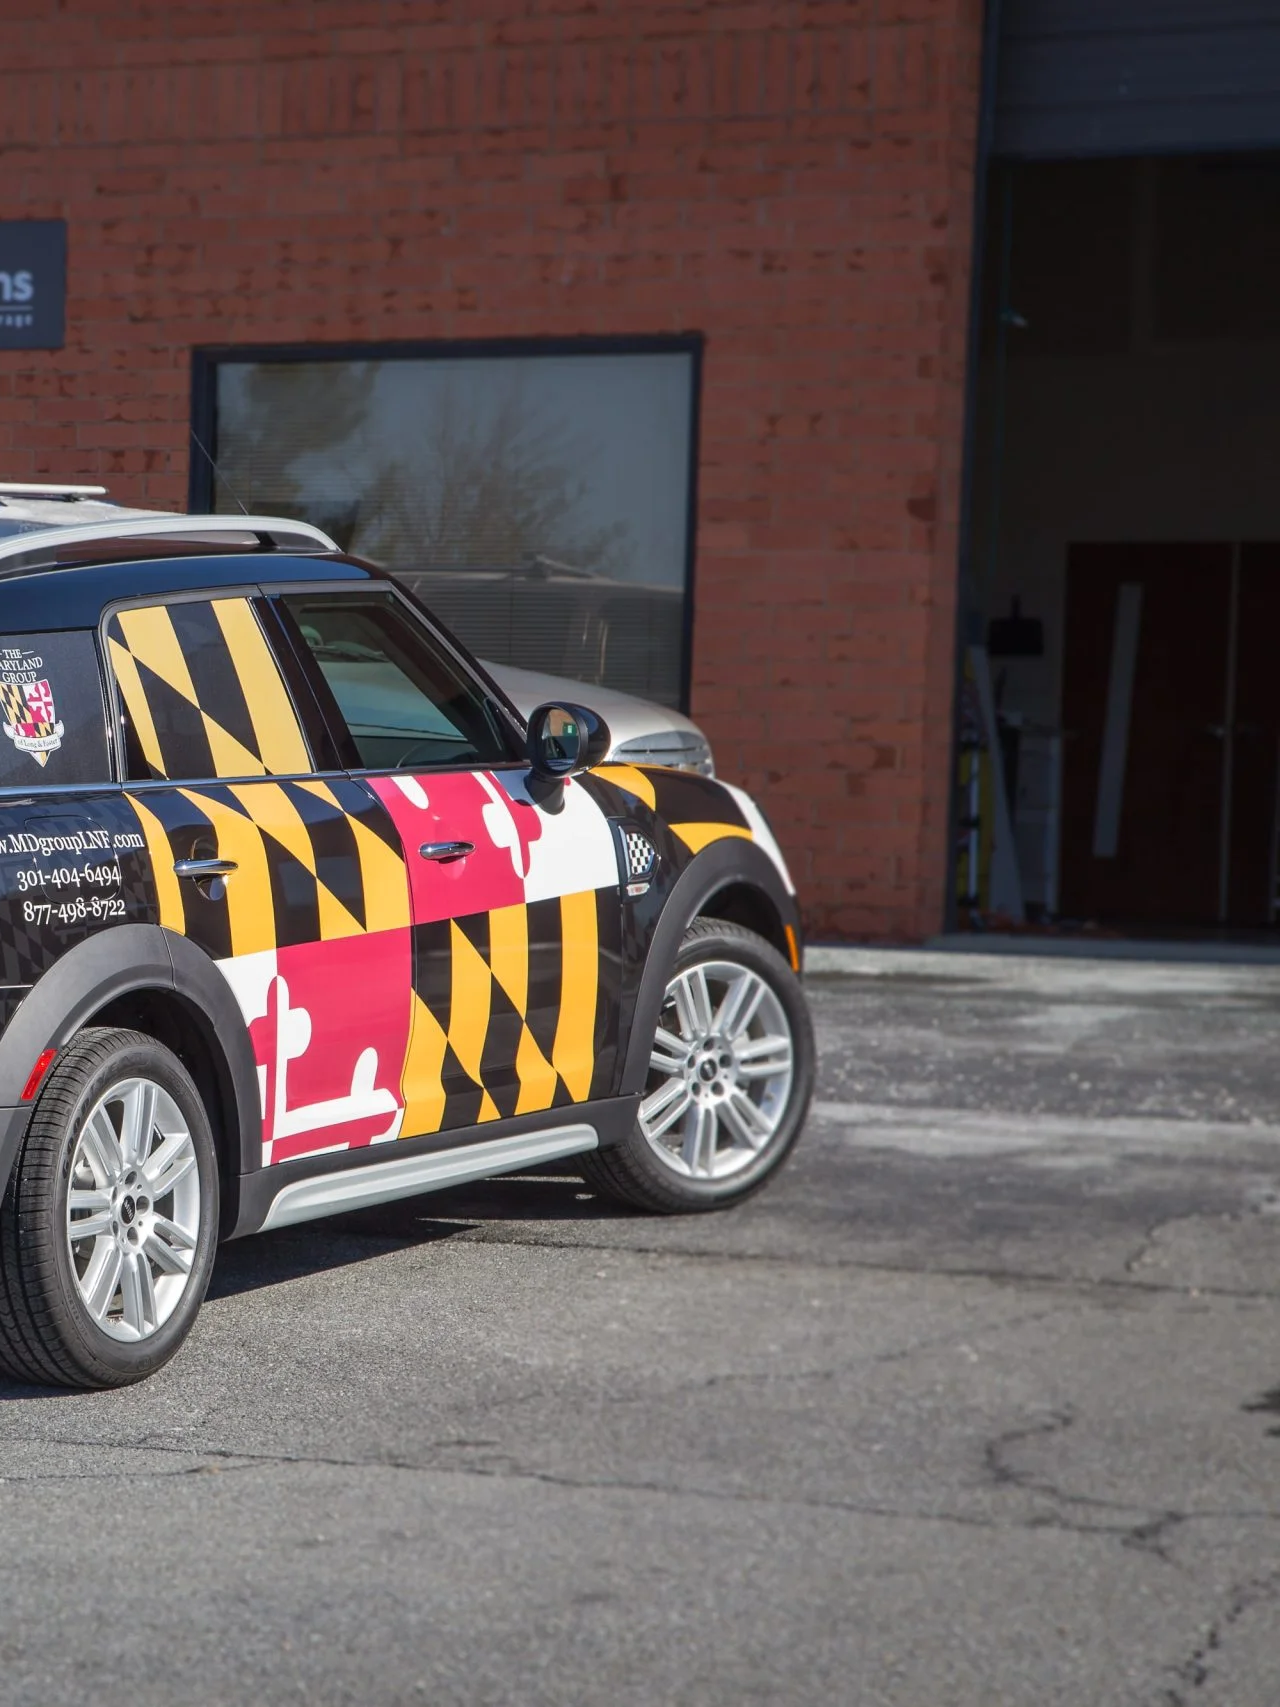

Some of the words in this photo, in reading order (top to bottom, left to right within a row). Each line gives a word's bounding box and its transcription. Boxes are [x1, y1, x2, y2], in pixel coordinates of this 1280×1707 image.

[1, 649, 23, 659] THE
[2, 672, 37, 684] GROUP
[17, 863, 122, 891] 301-404-6494
[23, 897, 126, 925] 877-498-8722
